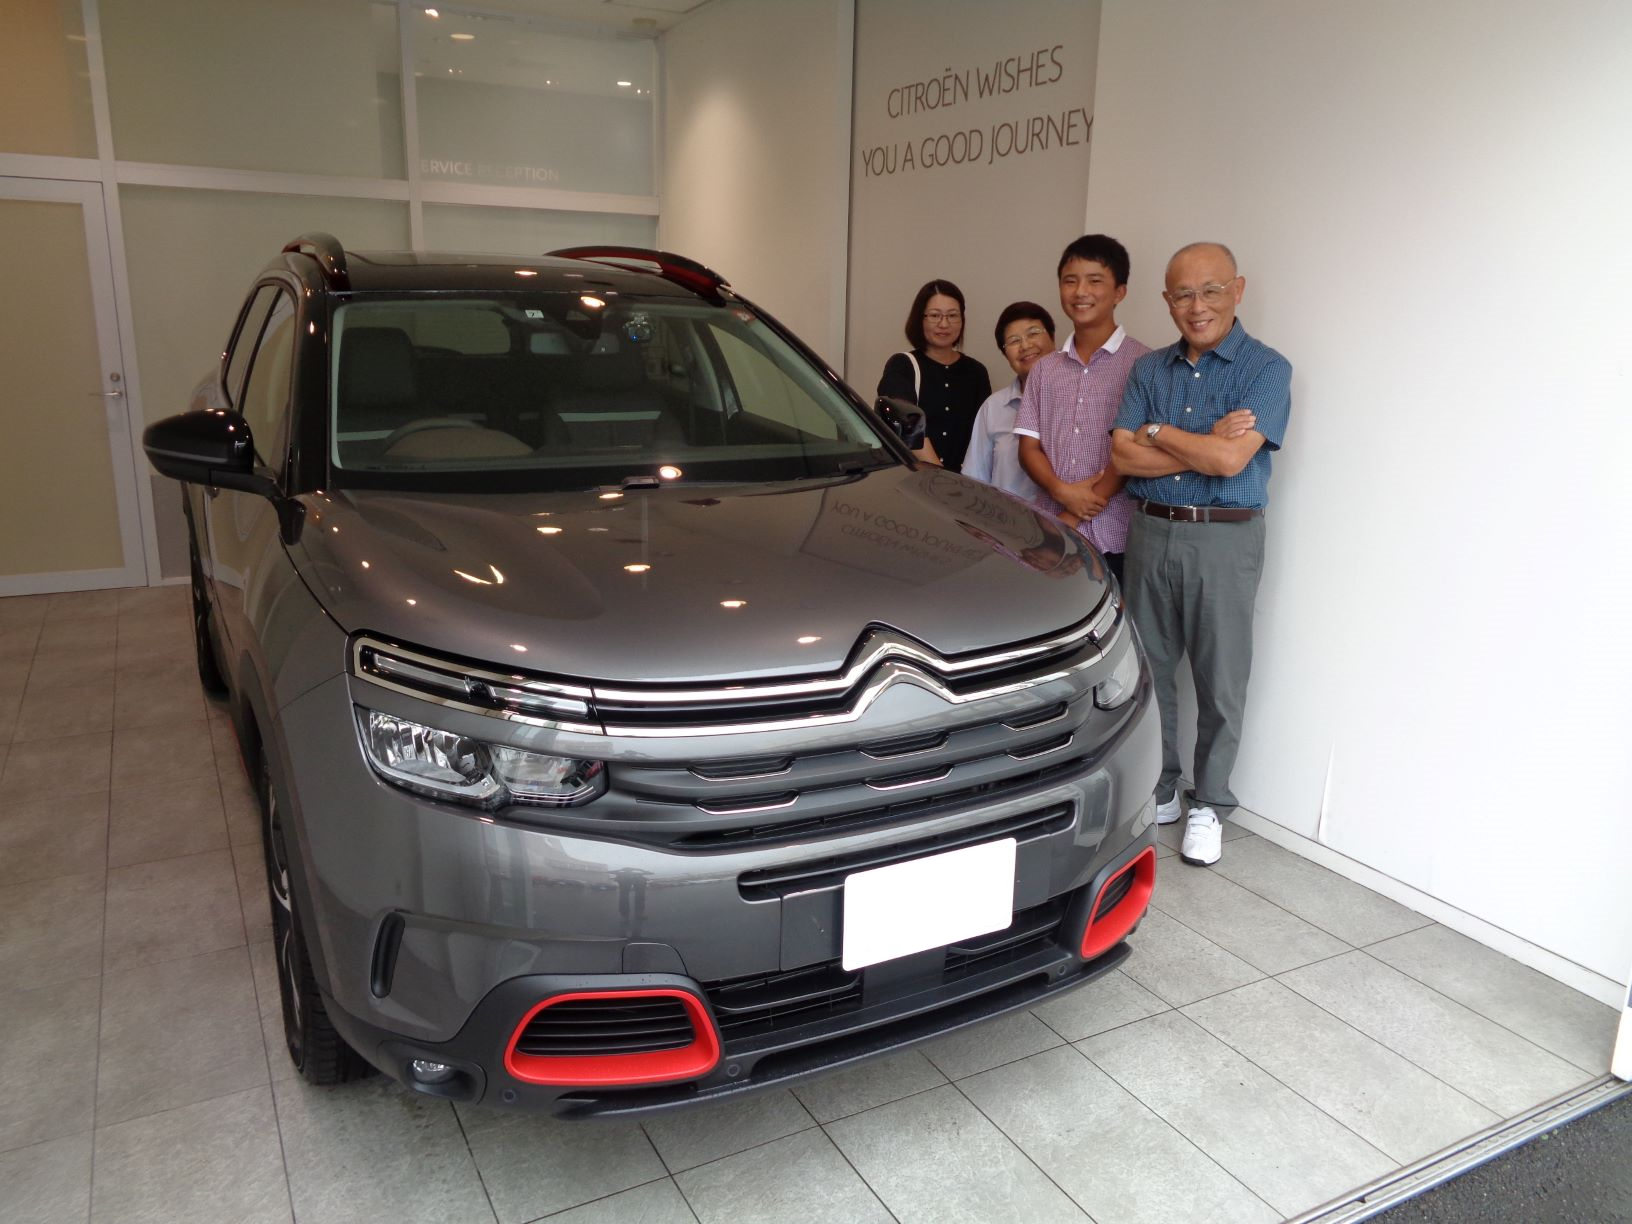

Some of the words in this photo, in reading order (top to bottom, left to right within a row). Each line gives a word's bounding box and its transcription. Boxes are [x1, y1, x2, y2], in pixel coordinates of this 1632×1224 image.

[887, 67, 970, 118] CITROËN
[976, 45, 1063, 99] WISHES
[421, 159, 473, 177] ERVICE
[862, 144, 898, 177] YOU
[901, 141, 915, 171] A
[920, 129, 983, 168] GOOD
[988, 107, 1094, 165] JOURNEY
